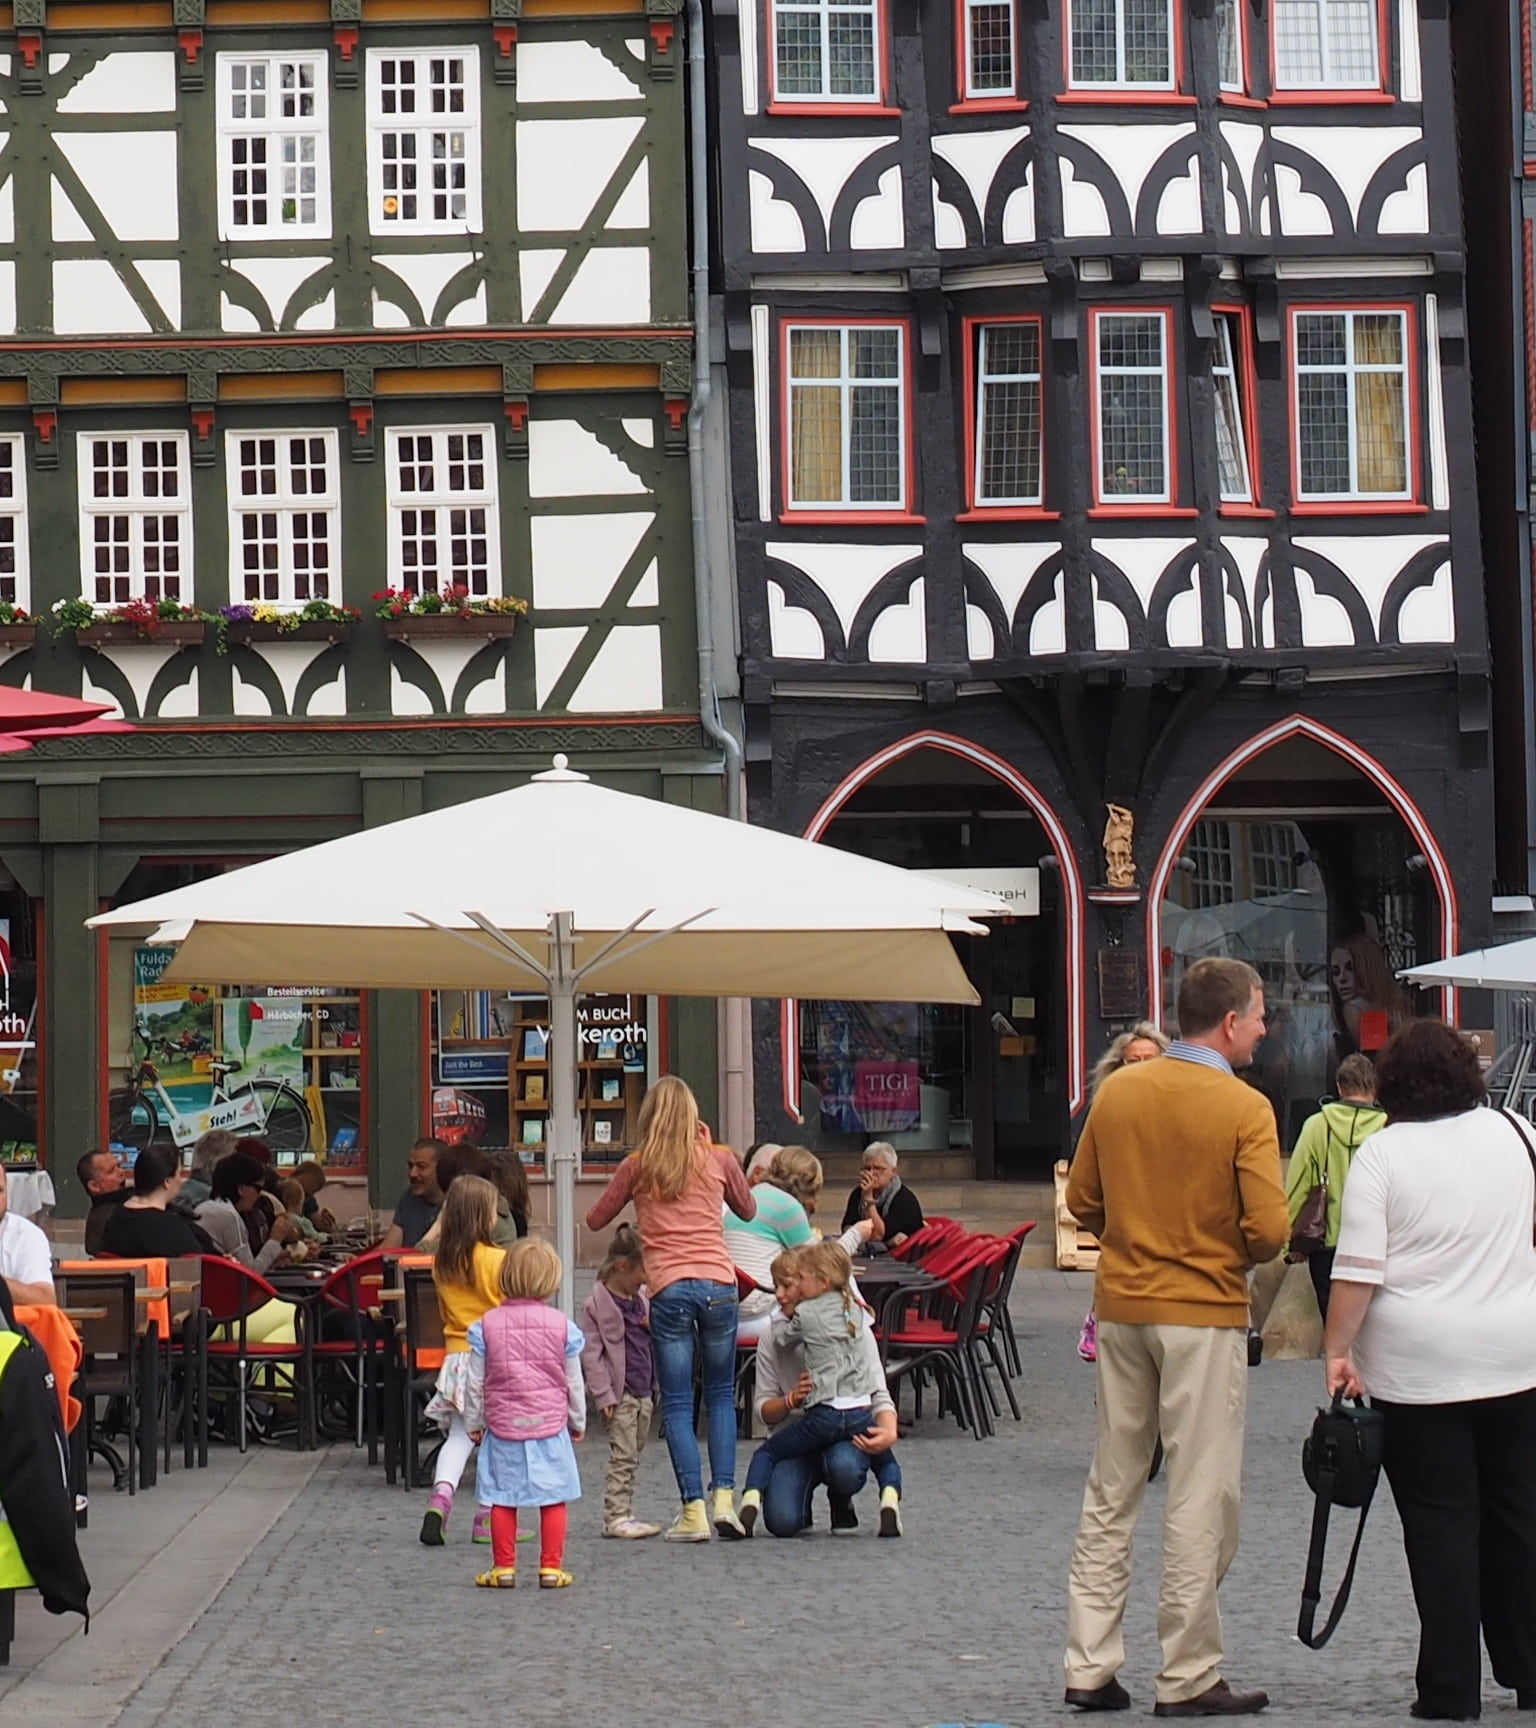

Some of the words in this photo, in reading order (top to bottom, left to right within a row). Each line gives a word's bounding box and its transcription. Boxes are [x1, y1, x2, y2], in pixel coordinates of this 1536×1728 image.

[316, 1009, 330, 1020] CD
[593, 1007, 632, 1022] BUCH
[536, 1021, 648, 1045] Vkeroth
[865, 1073, 910, 1092] TIGI
